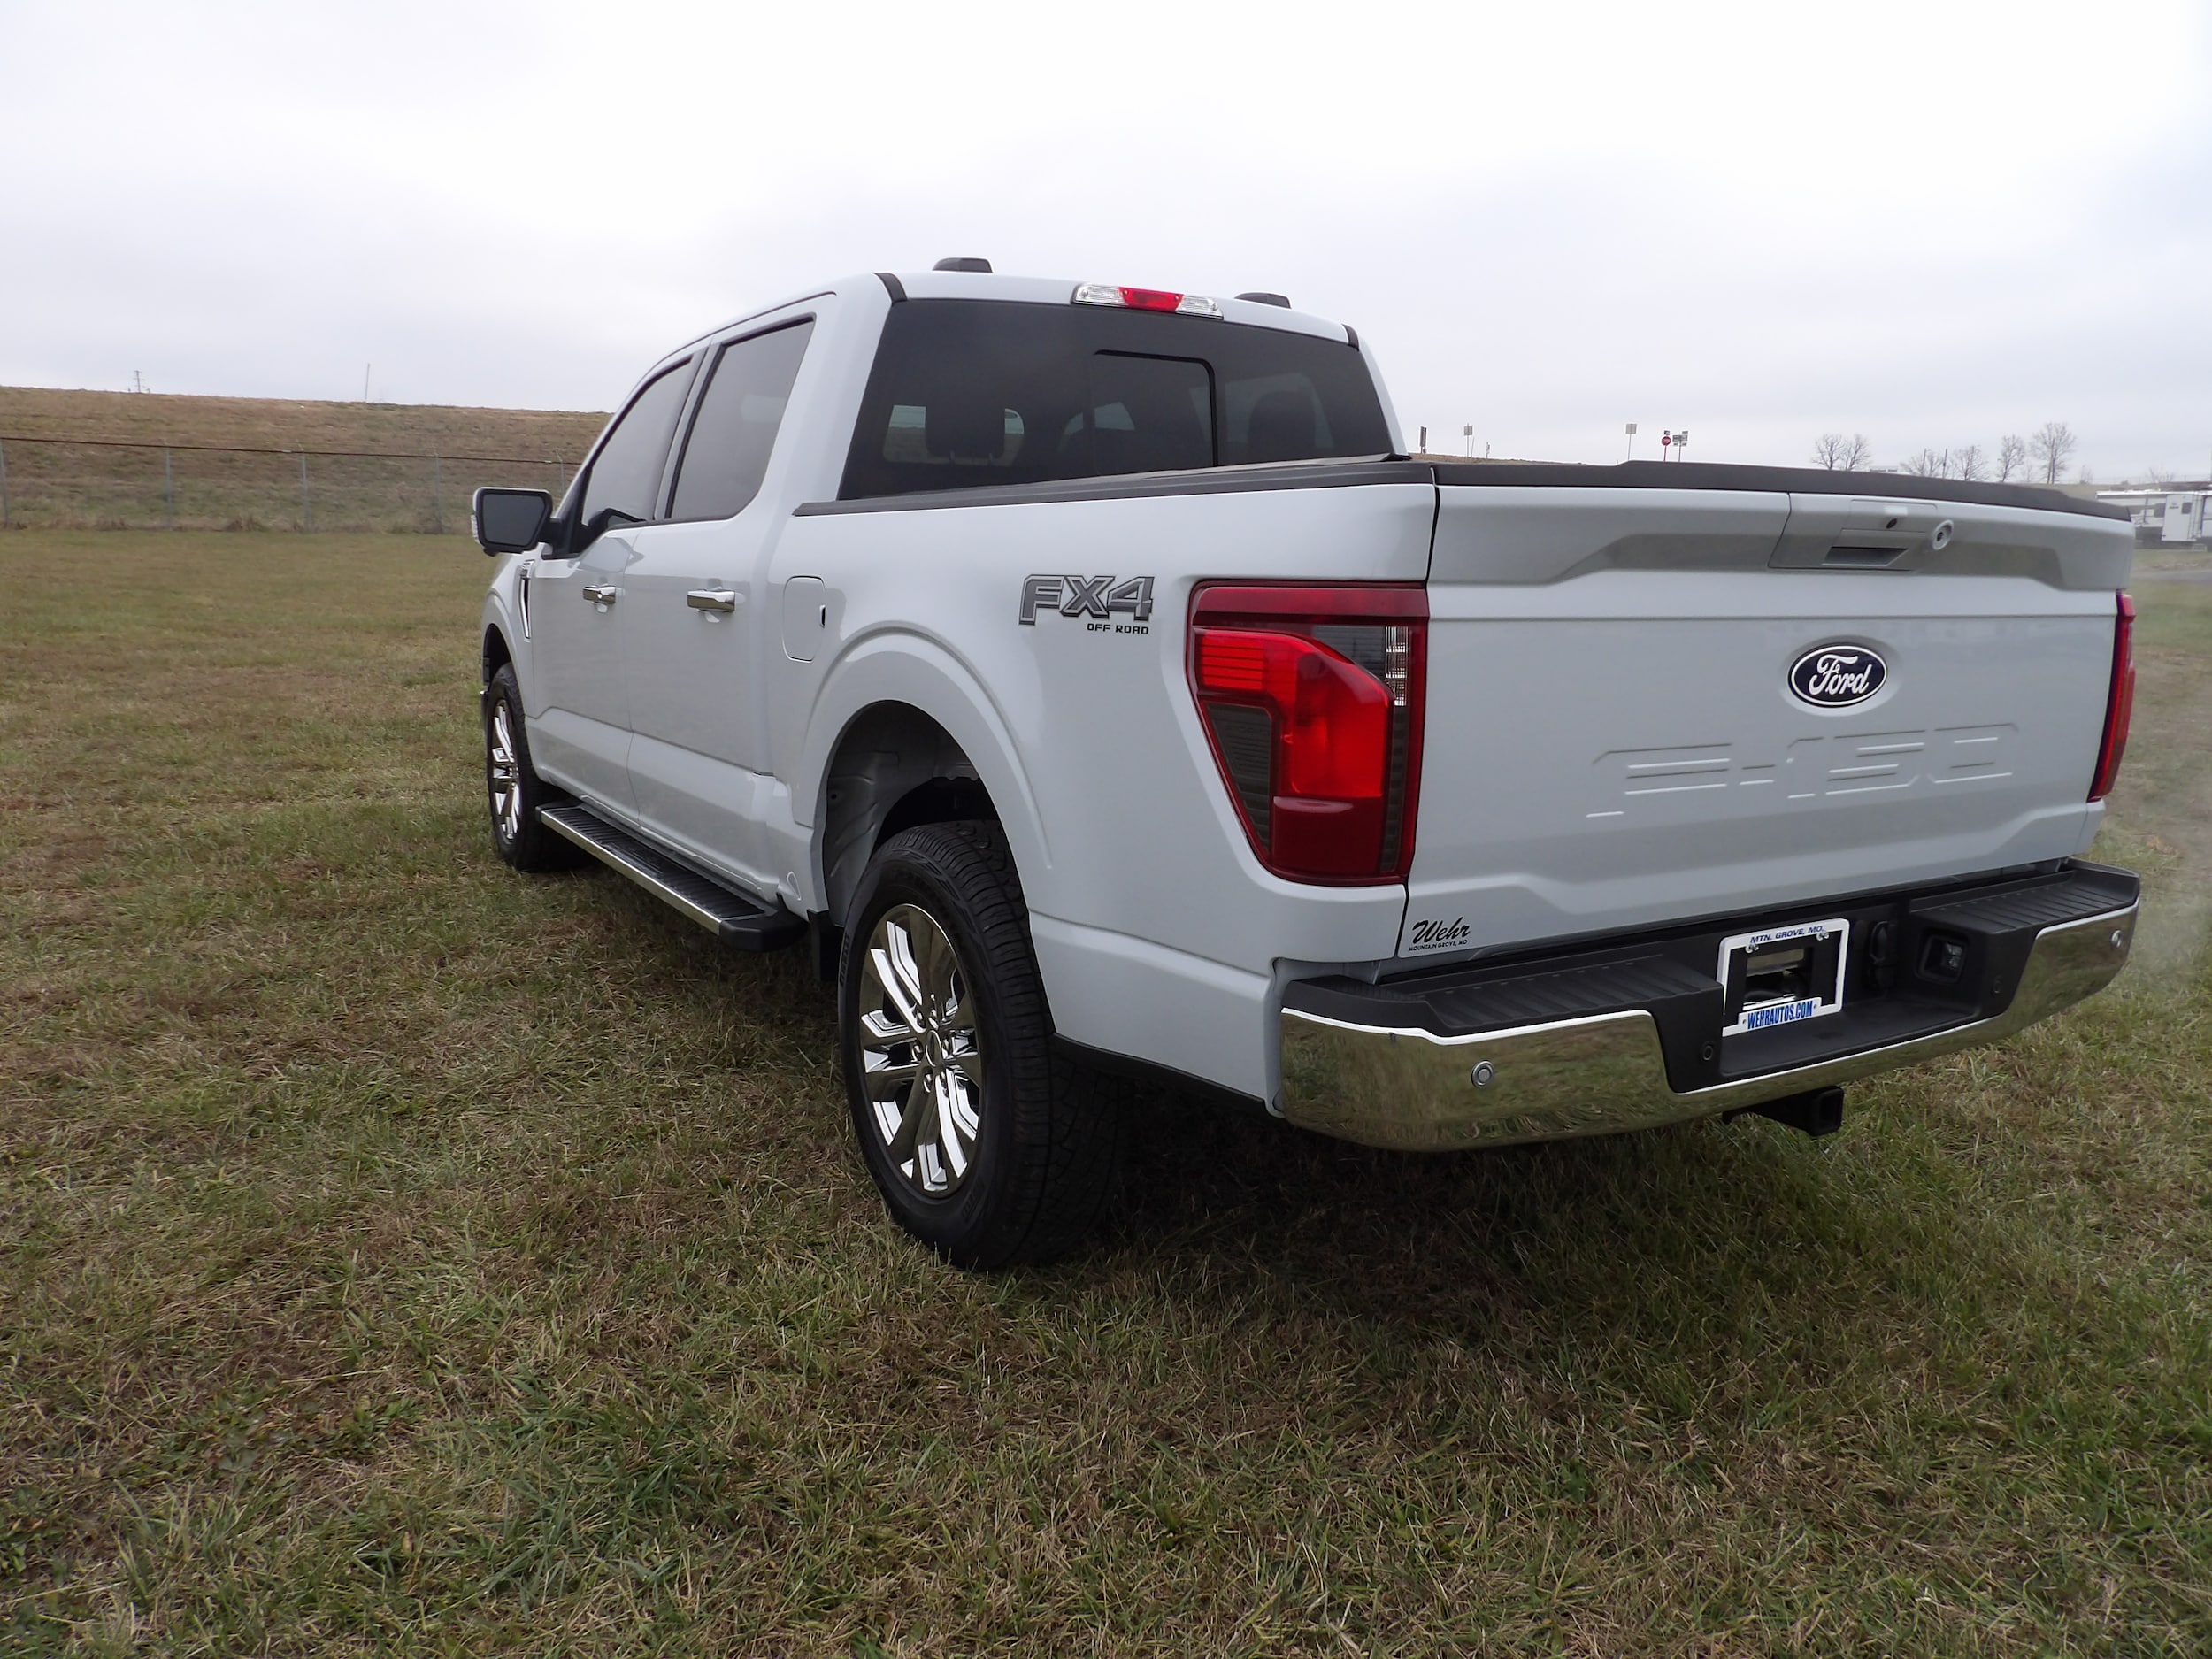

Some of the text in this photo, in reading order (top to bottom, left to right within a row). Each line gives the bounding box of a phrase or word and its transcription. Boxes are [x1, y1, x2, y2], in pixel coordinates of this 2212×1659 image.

[1019, 574, 1154, 625] FX4
[1087, 623, 1148, 635] OFF ROAD
[1809, 654, 1872, 695] Ford
[1586, 722, 2019, 818] F-150
[1412, 917, 1471, 944] Wehr
[1750, 934, 1772, 944] MTN.
[1409, 942, 1437, 951] MOUNTAIN
[1747, 1001, 1813, 1029] WEHRAUTOS.COM
